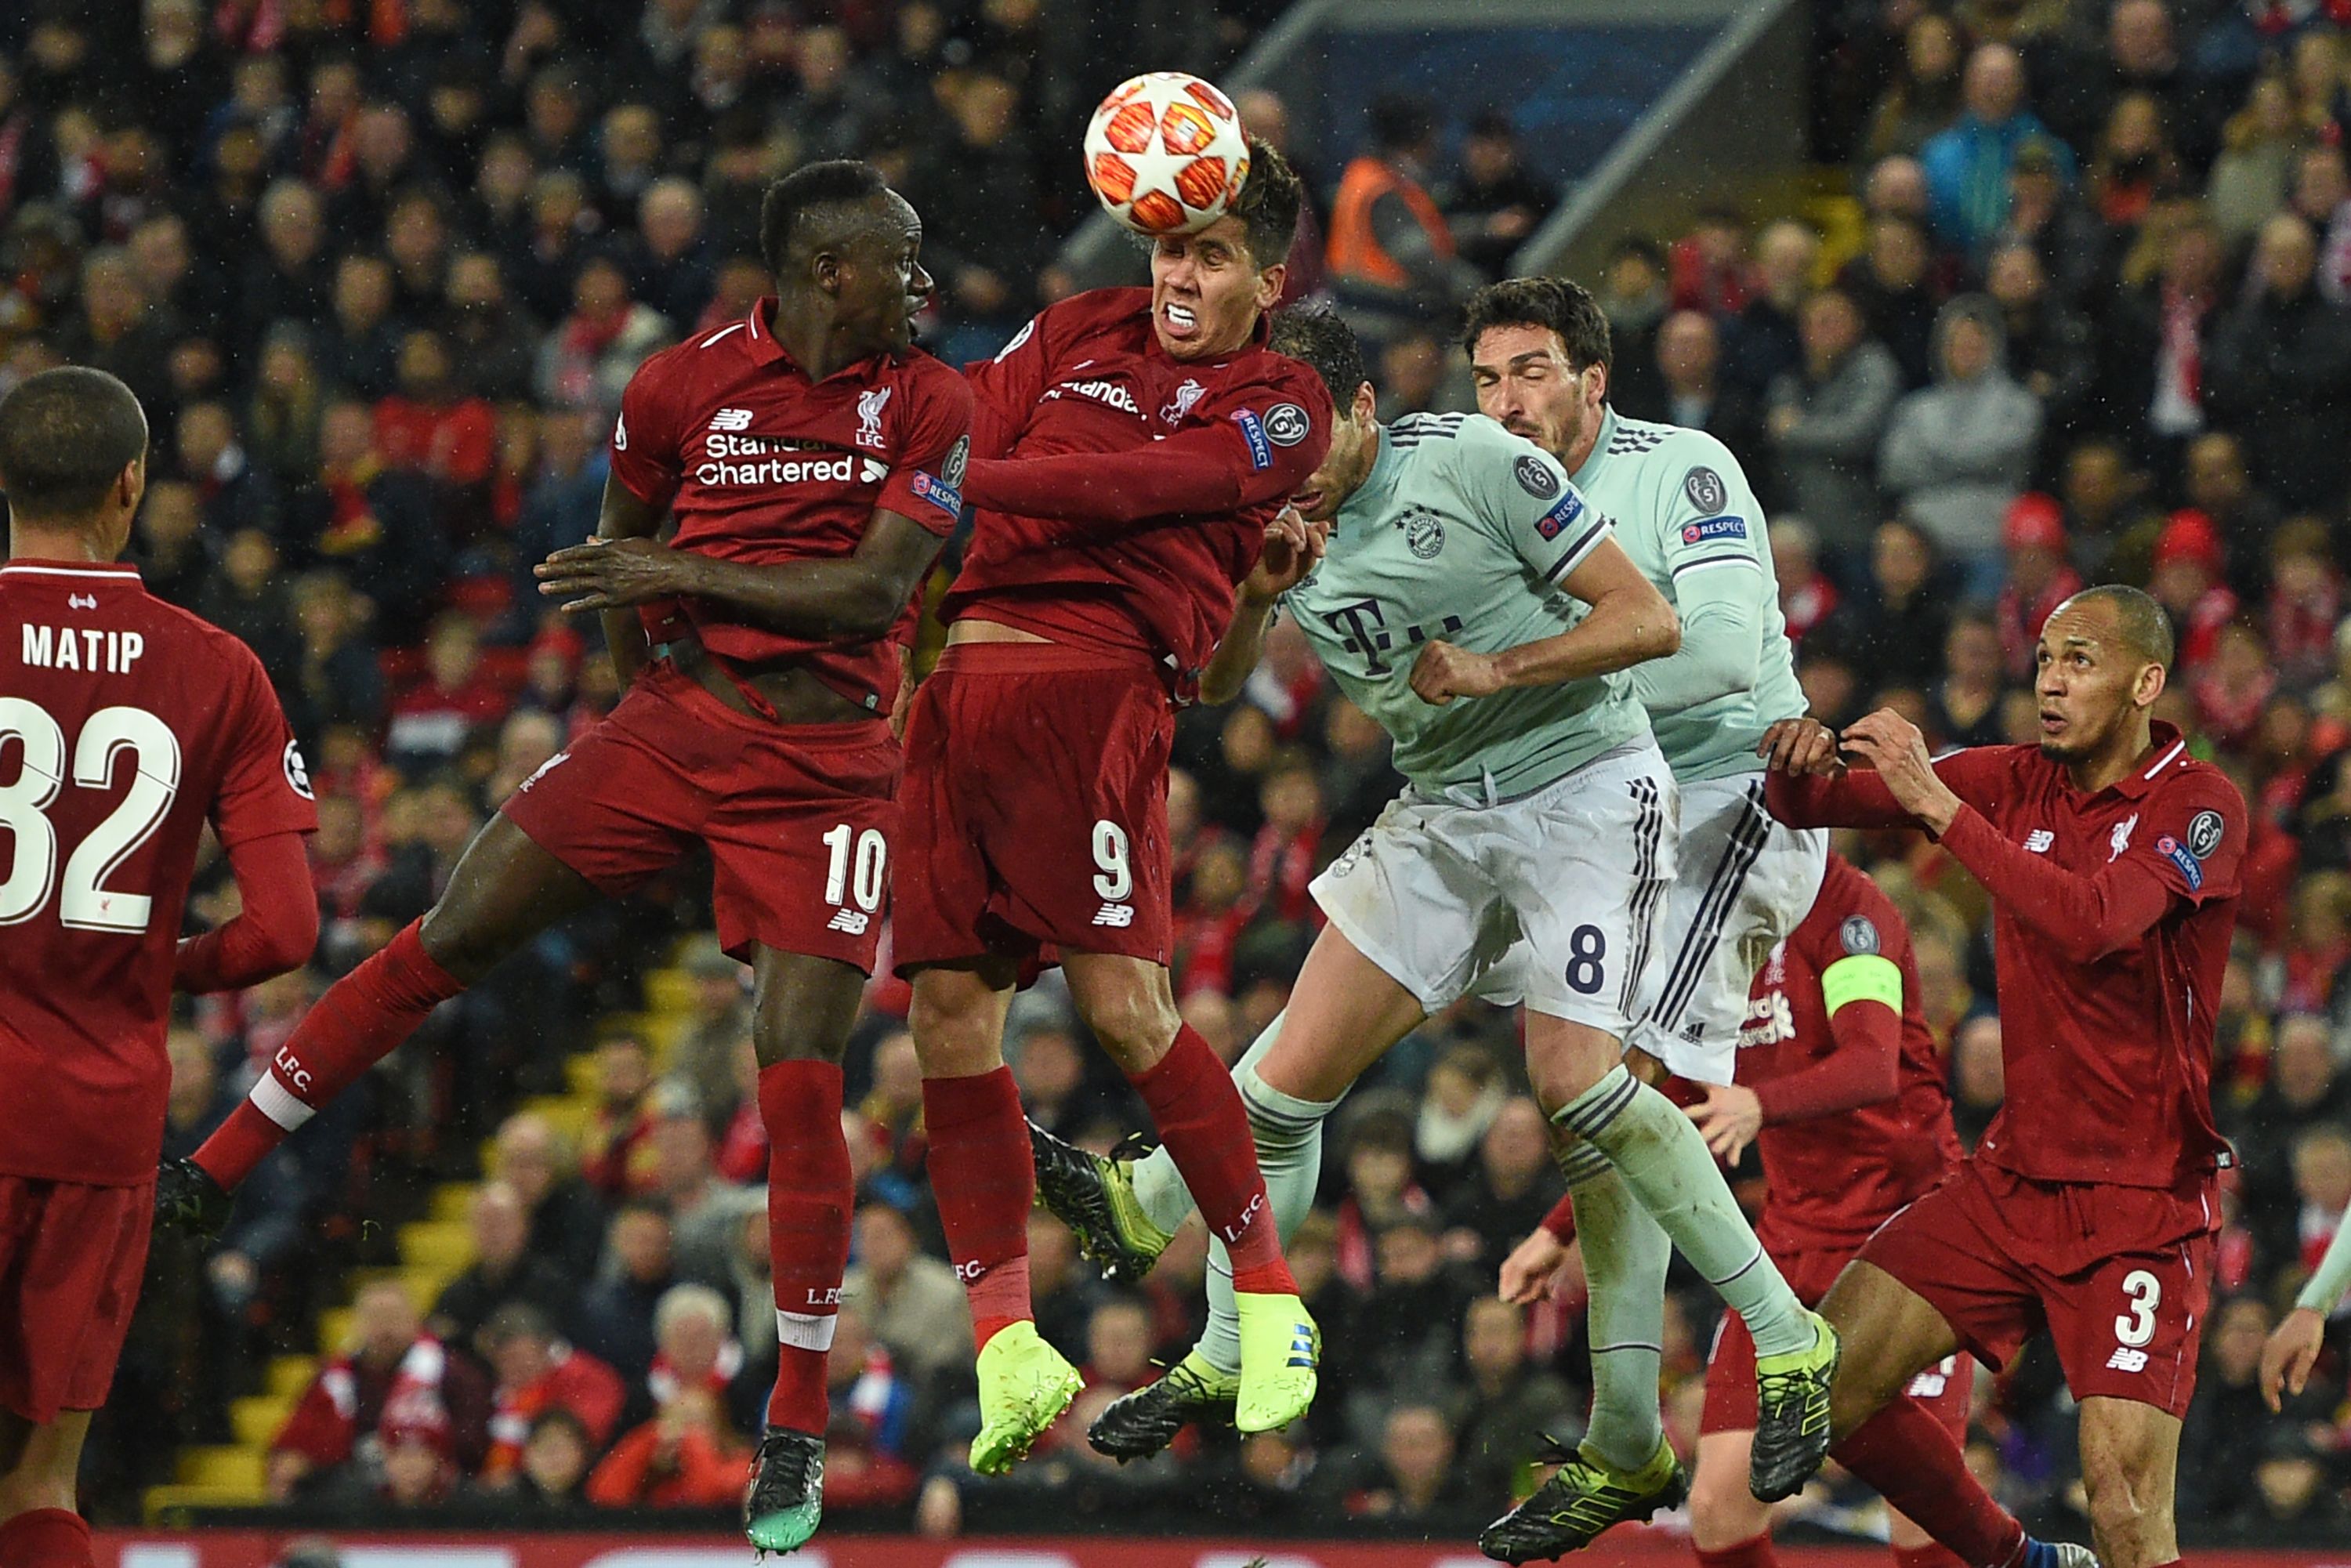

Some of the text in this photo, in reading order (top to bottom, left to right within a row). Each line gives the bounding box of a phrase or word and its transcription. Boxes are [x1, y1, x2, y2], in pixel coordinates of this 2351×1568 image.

[1244, 416, 1270, 468] RESPECT
[1274, 421, 1289, 432] 5
[695, 455, 853, 486] Chartered
[1535, 473, 1547, 486] 5
[1703, 488, 1714, 502] 5
[1701, 521, 1744, 535] RESPECT
[22, 624, 143, 674] MATIP
[0, 697, 182, 934] 32
[2197, 832, 2209, 846] 5
[823, 824, 887, 913] 10
[1092, 820, 1133, 902] 9
[1565, 924, 1607, 994] 8
[2115, 1270, 2161, 1348] 3
